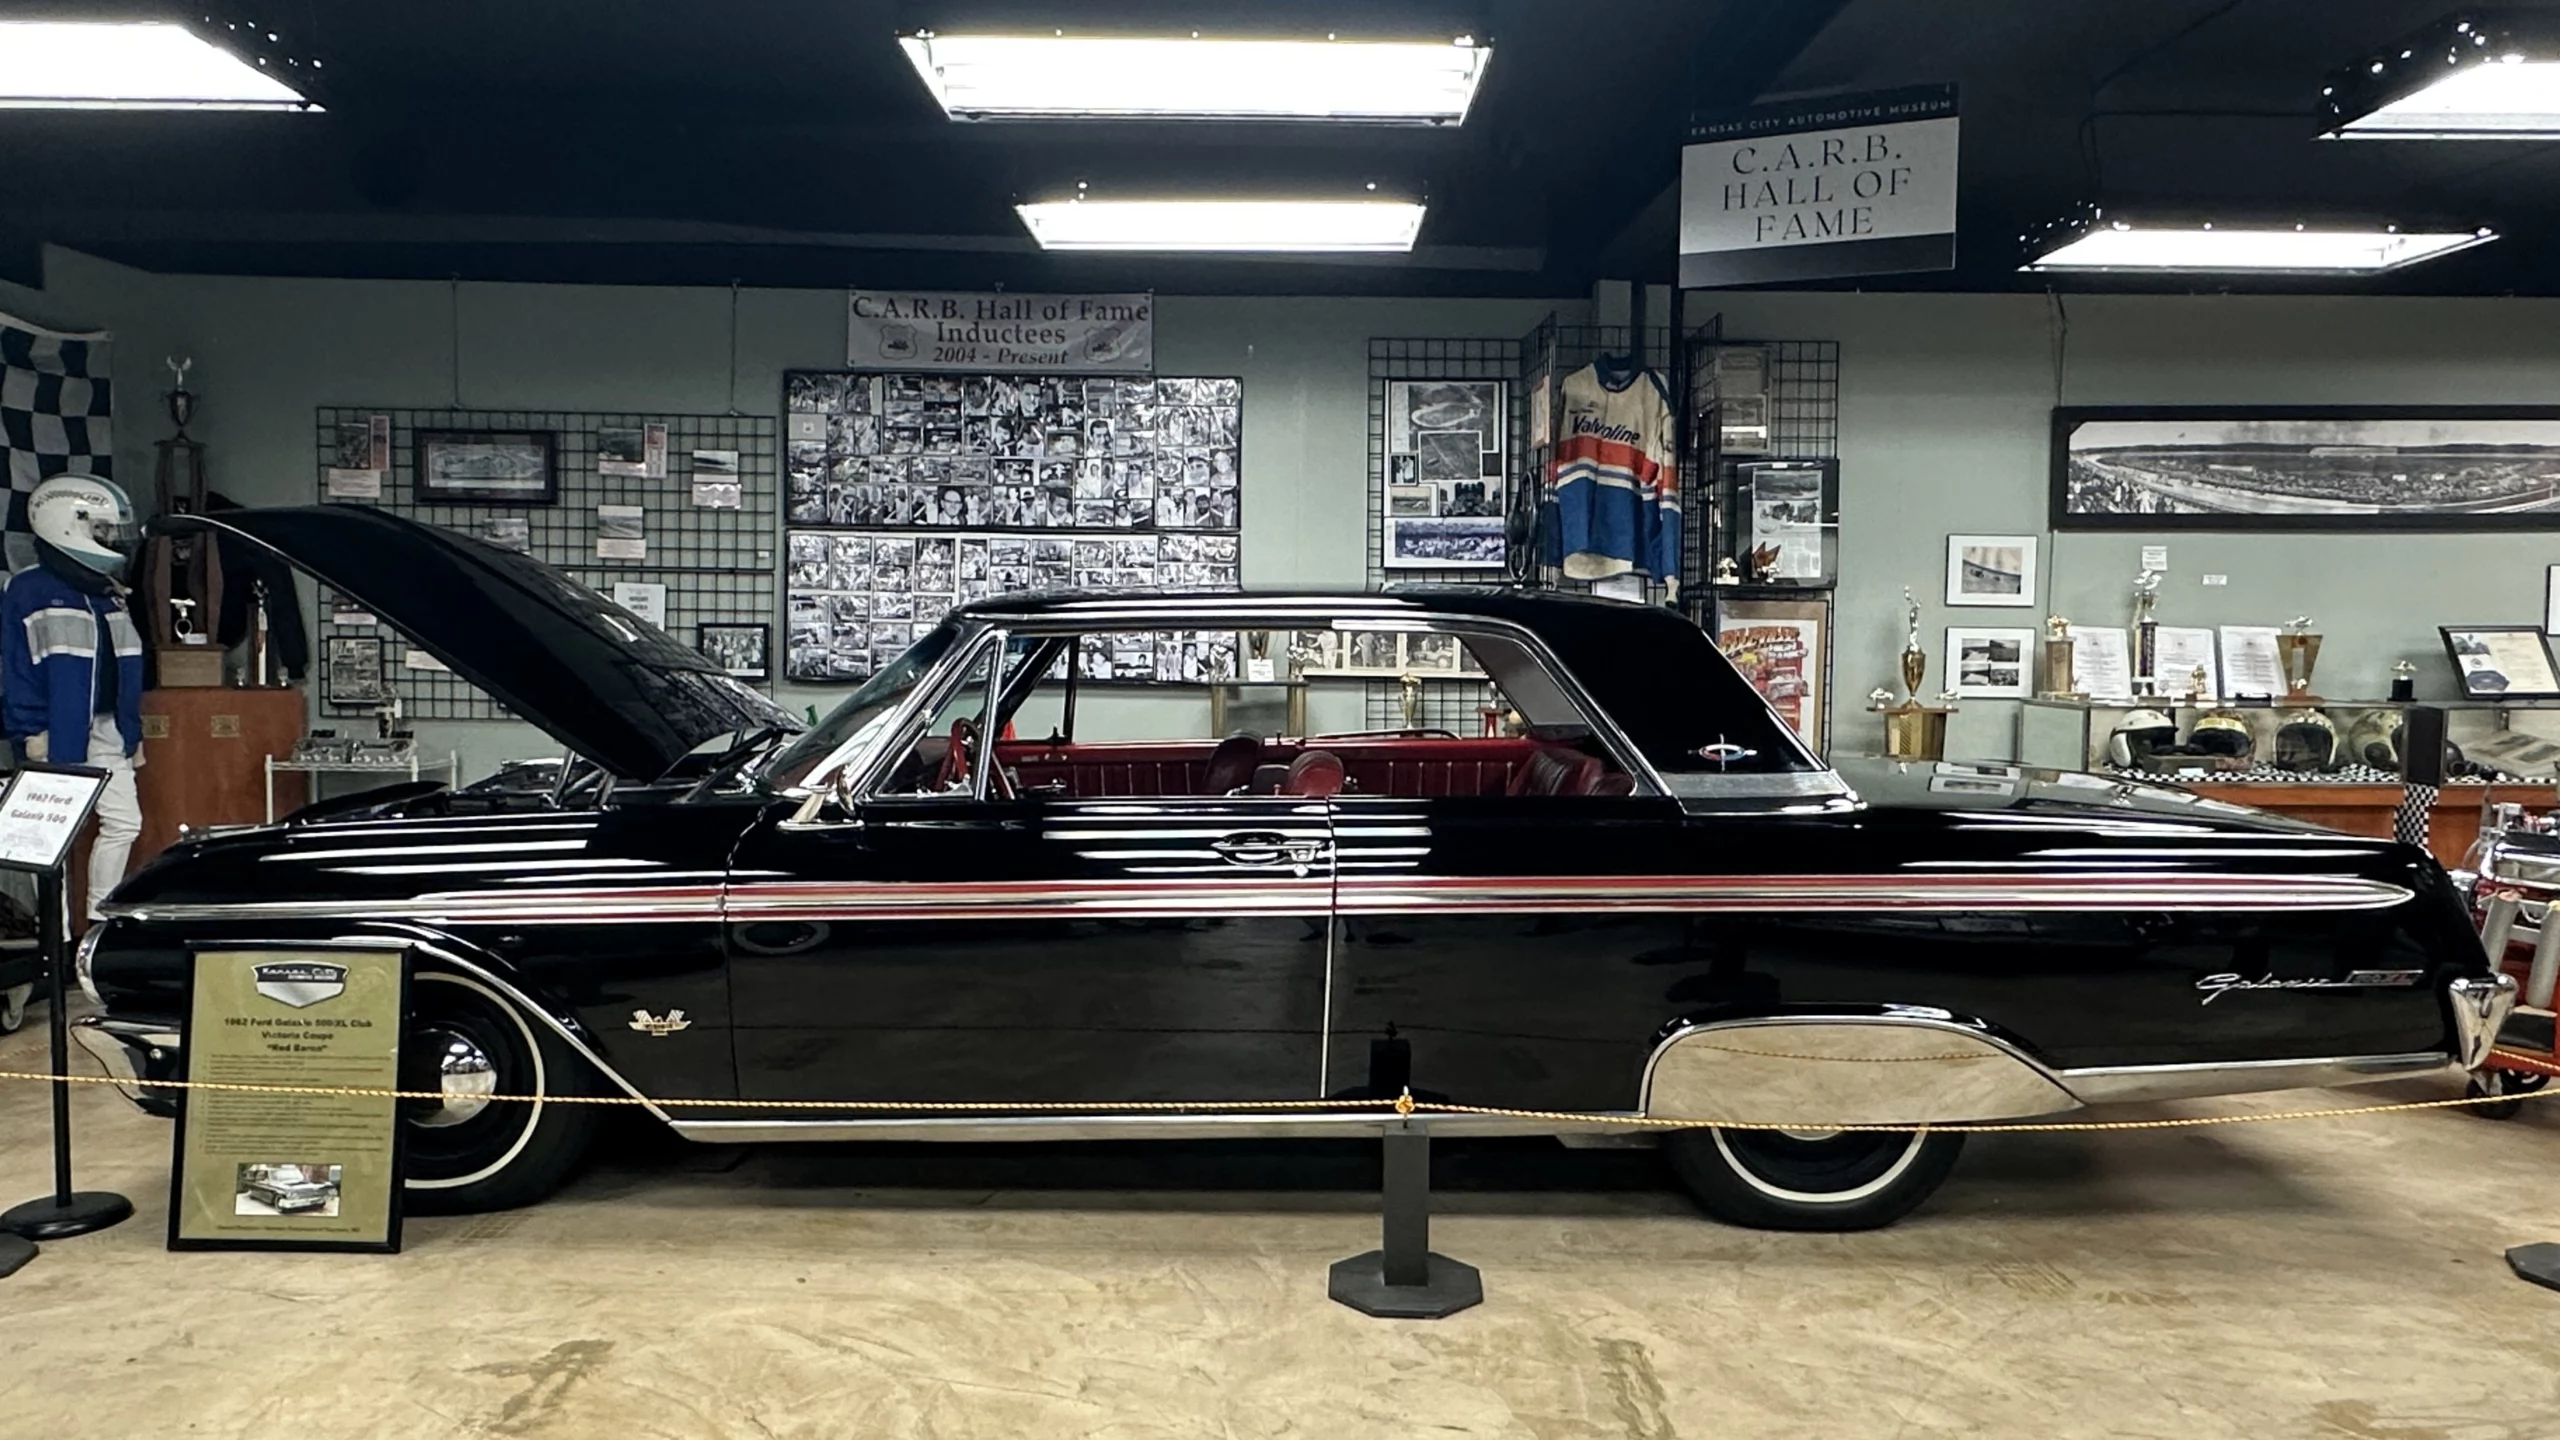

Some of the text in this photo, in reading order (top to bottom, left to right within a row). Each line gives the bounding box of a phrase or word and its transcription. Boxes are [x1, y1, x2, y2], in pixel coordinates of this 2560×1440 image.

[1690, 100, 1951, 136] KANSAS CITY AUTOMOTIVE MUSEUM
[1732, 134, 1902, 175] C.A.R.B.
[1723, 167, 1911, 211] HALL OF
[1755, 207, 1874, 242] FAME
[852, 297, 1149, 322] C.A.R.B. Hall of Fame
[937, 321, 1066, 344] Inductees
[933, 346, 976, 363] 2004
[998, 348, 1068, 365] Present
[1572, 415, 1641, 445] Valvoline
[49, 794, 73, 805] Ford
